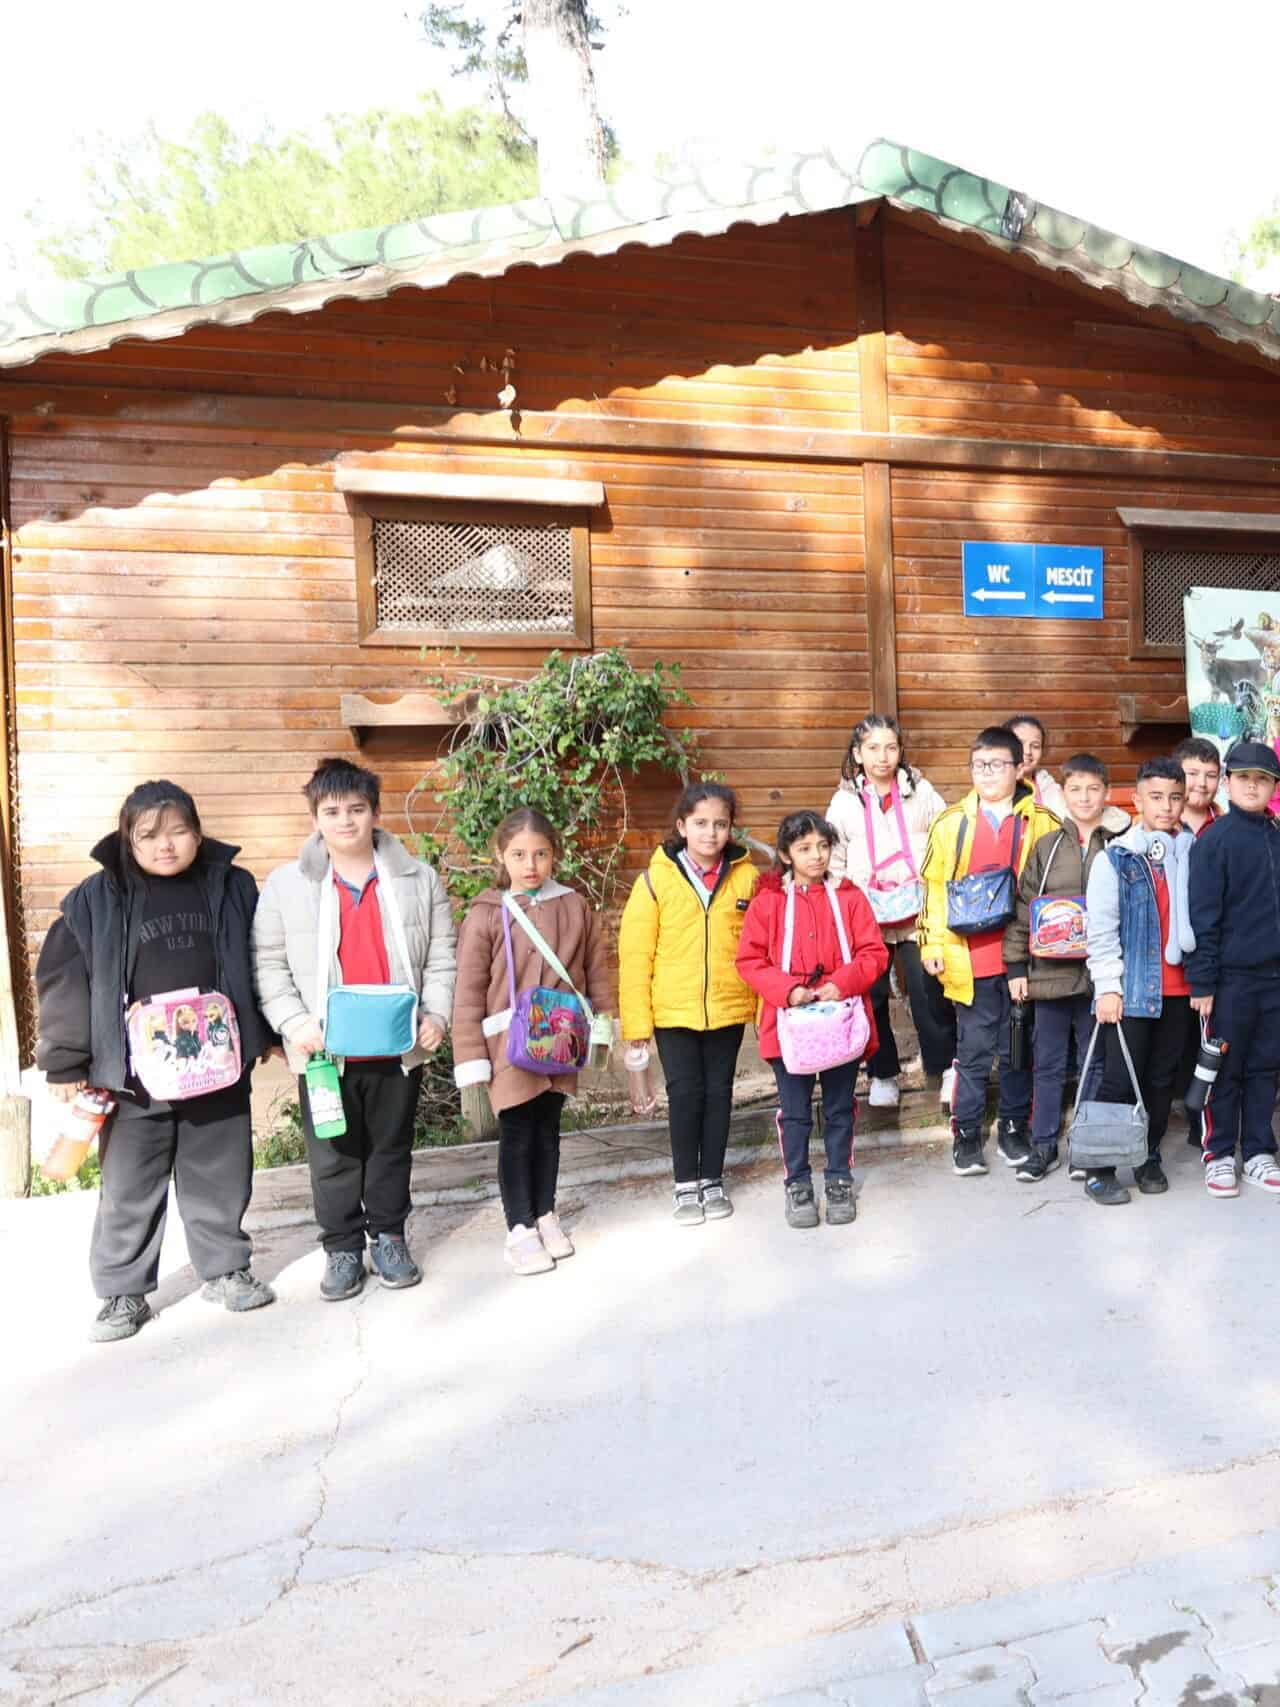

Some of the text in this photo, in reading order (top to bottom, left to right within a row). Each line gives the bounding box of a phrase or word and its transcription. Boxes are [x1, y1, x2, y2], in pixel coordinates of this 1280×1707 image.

[987, 564, 1010, 584] WC
[1046, 565, 1094, 587] MESCİT
[140, 911, 207, 944] NEW YOR
